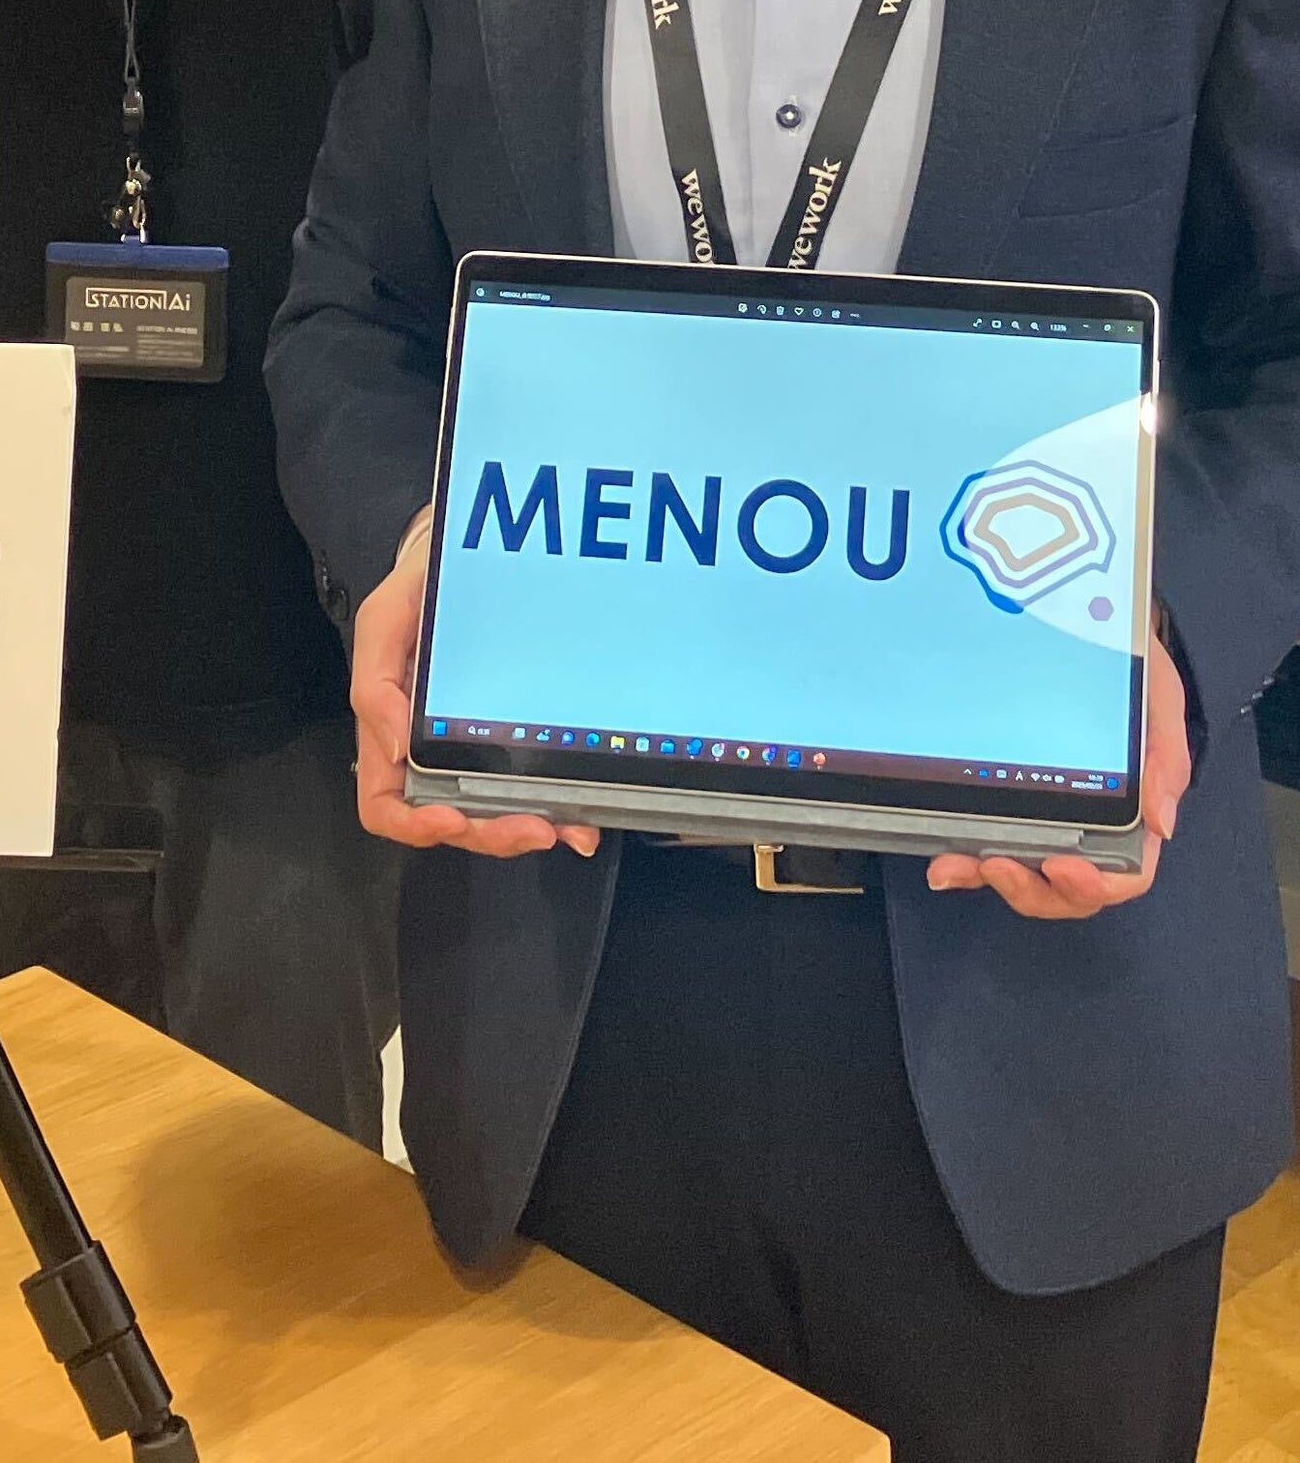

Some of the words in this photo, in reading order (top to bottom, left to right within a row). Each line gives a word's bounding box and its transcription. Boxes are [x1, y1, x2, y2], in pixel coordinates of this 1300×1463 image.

[681, 168, 714, 265] wewo
[90, 292, 164, 310] STATION
[168, 293, 191, 311] Ai
[461, 460, 911, 581] MENOU
